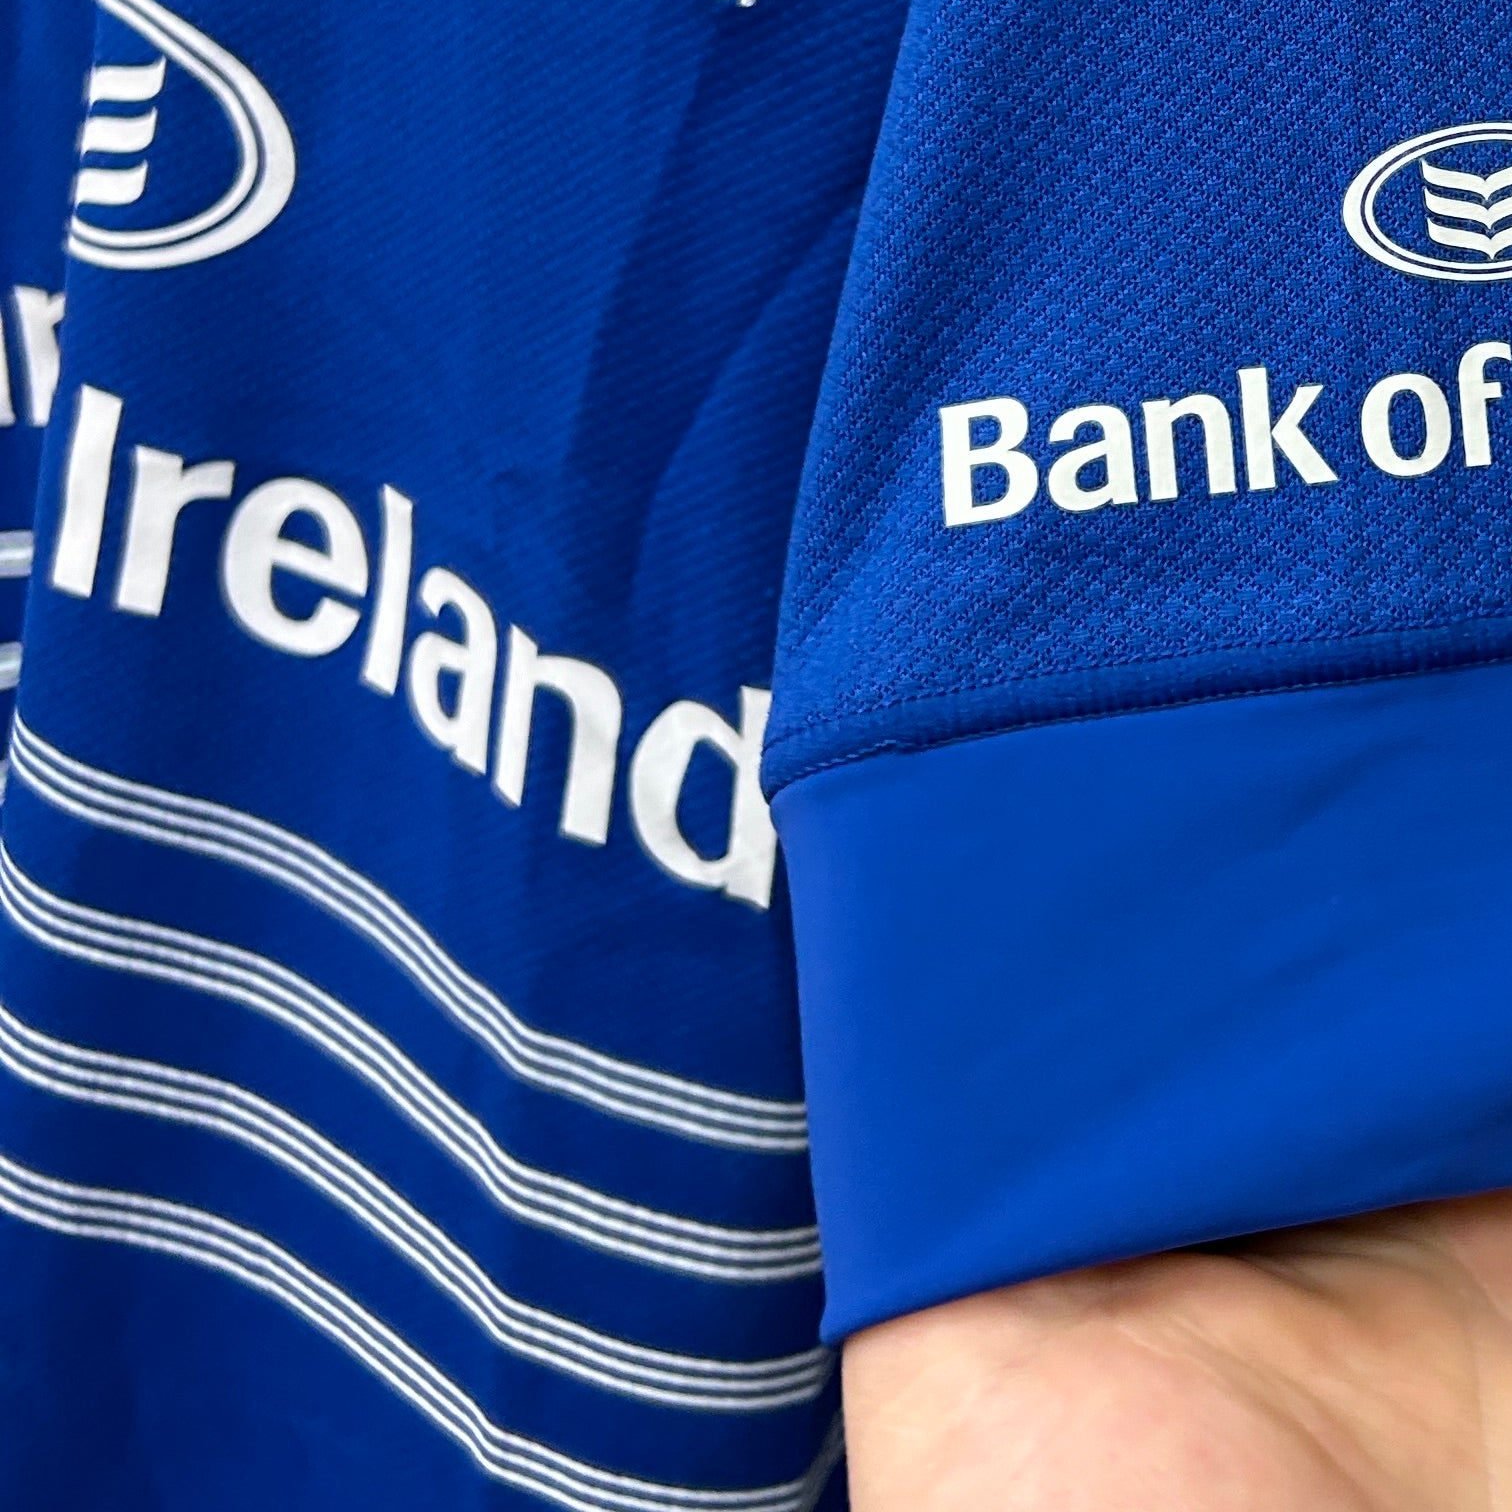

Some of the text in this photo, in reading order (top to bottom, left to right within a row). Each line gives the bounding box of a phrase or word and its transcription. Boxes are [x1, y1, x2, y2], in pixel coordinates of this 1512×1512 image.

[938, 366, 1340, 529] Bank
[1360, 341, 1512, 477] of
[50, 384, 778, 909] Ireland
